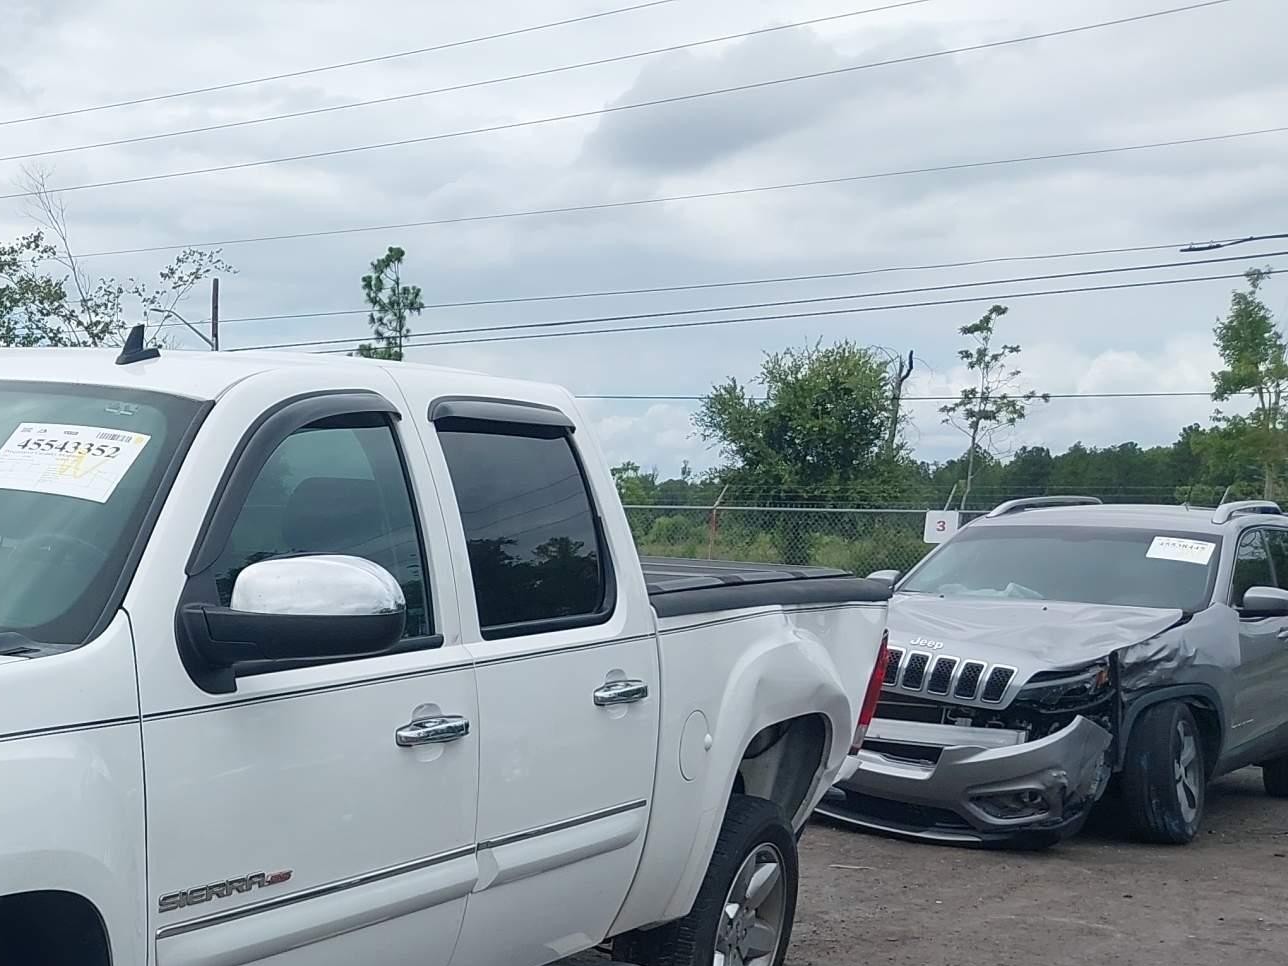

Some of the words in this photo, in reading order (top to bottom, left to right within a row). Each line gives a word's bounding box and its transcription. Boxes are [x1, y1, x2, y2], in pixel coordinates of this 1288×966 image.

[16, 438, 121, 459] 45543352
[936, 520, 946, 532] 3
[910, 637, 944, 650] Jeep
[158, 870, 267, 913] SIERRA
